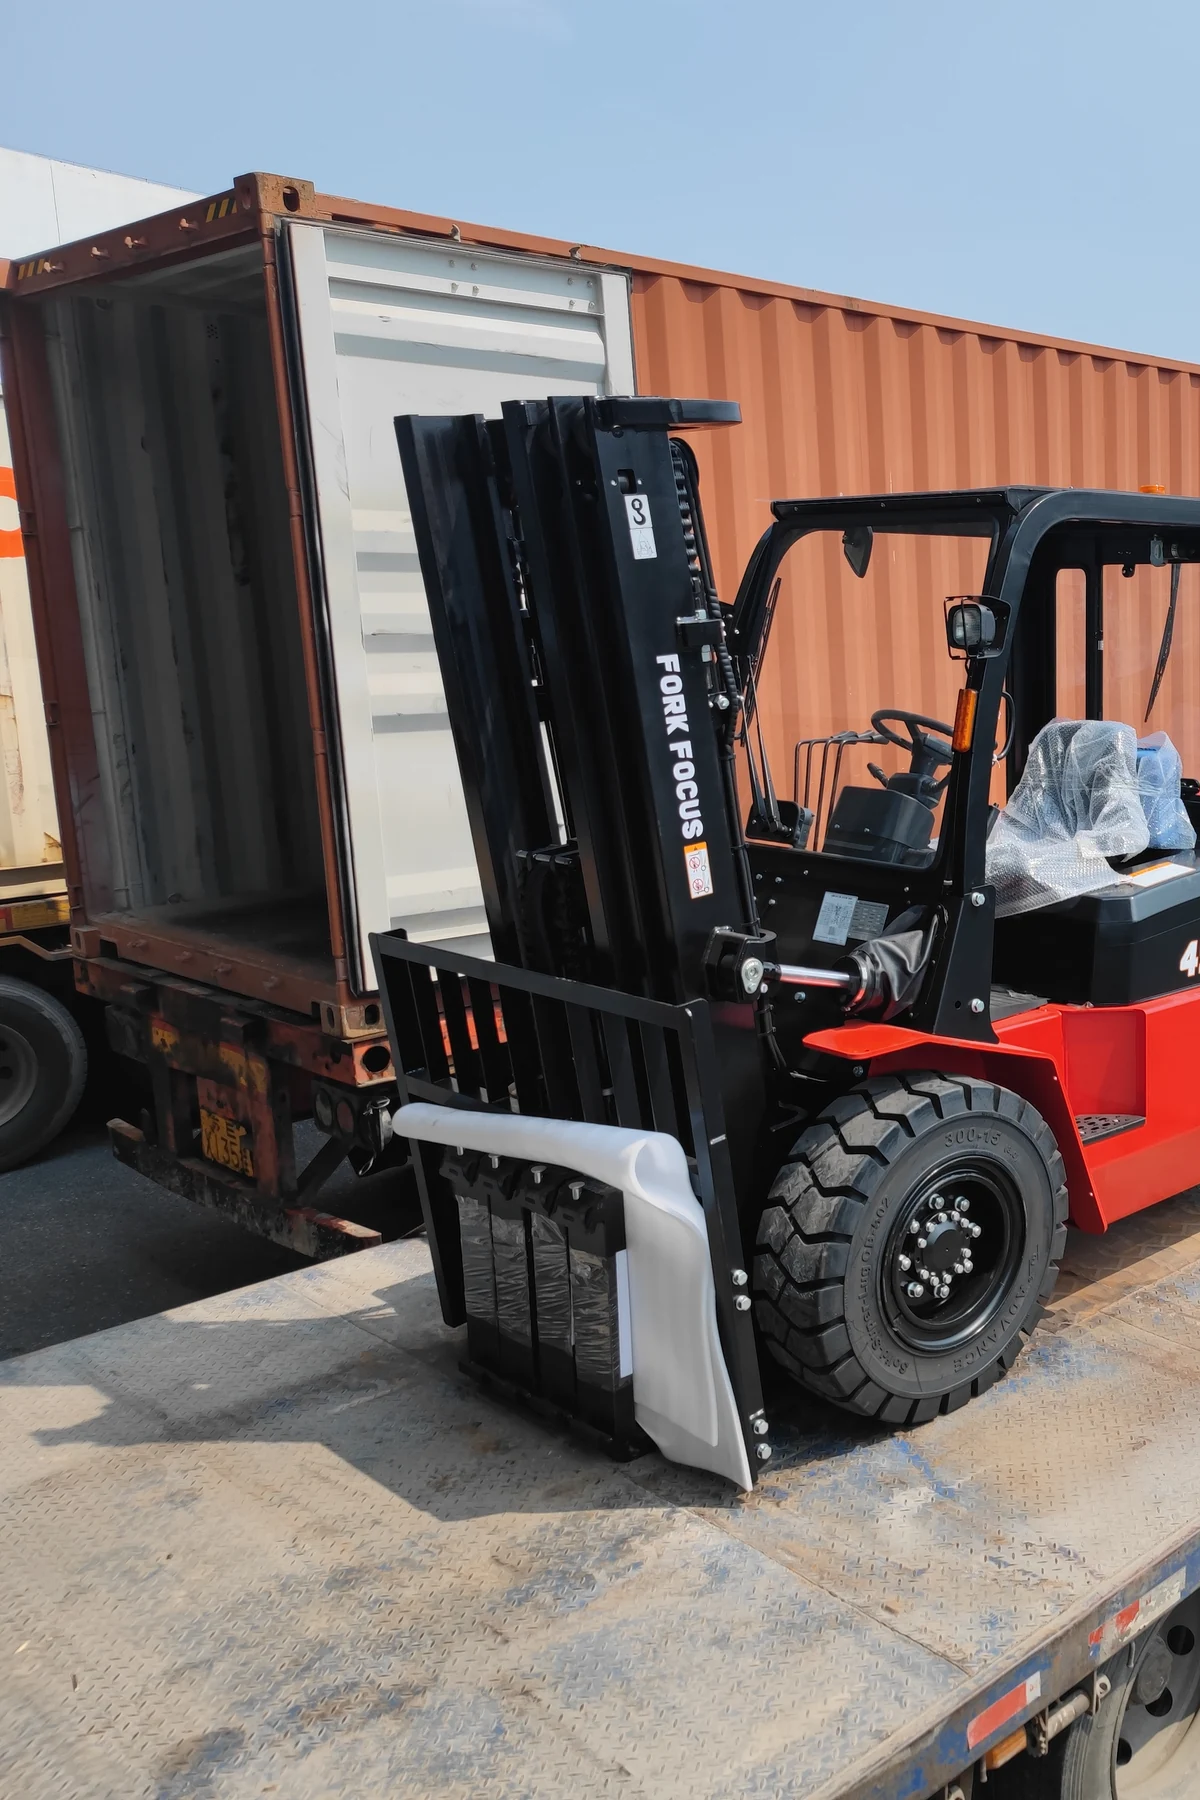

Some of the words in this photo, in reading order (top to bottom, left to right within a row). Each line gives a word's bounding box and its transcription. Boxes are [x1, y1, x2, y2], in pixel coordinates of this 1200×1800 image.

[656, 653, 690, 736] FORK
[669, 740, 704, 840] FOCUS
[944, 1127, 1002, 1148] 300-15
[953, 1284, 1028, 1374] ADVANCE
